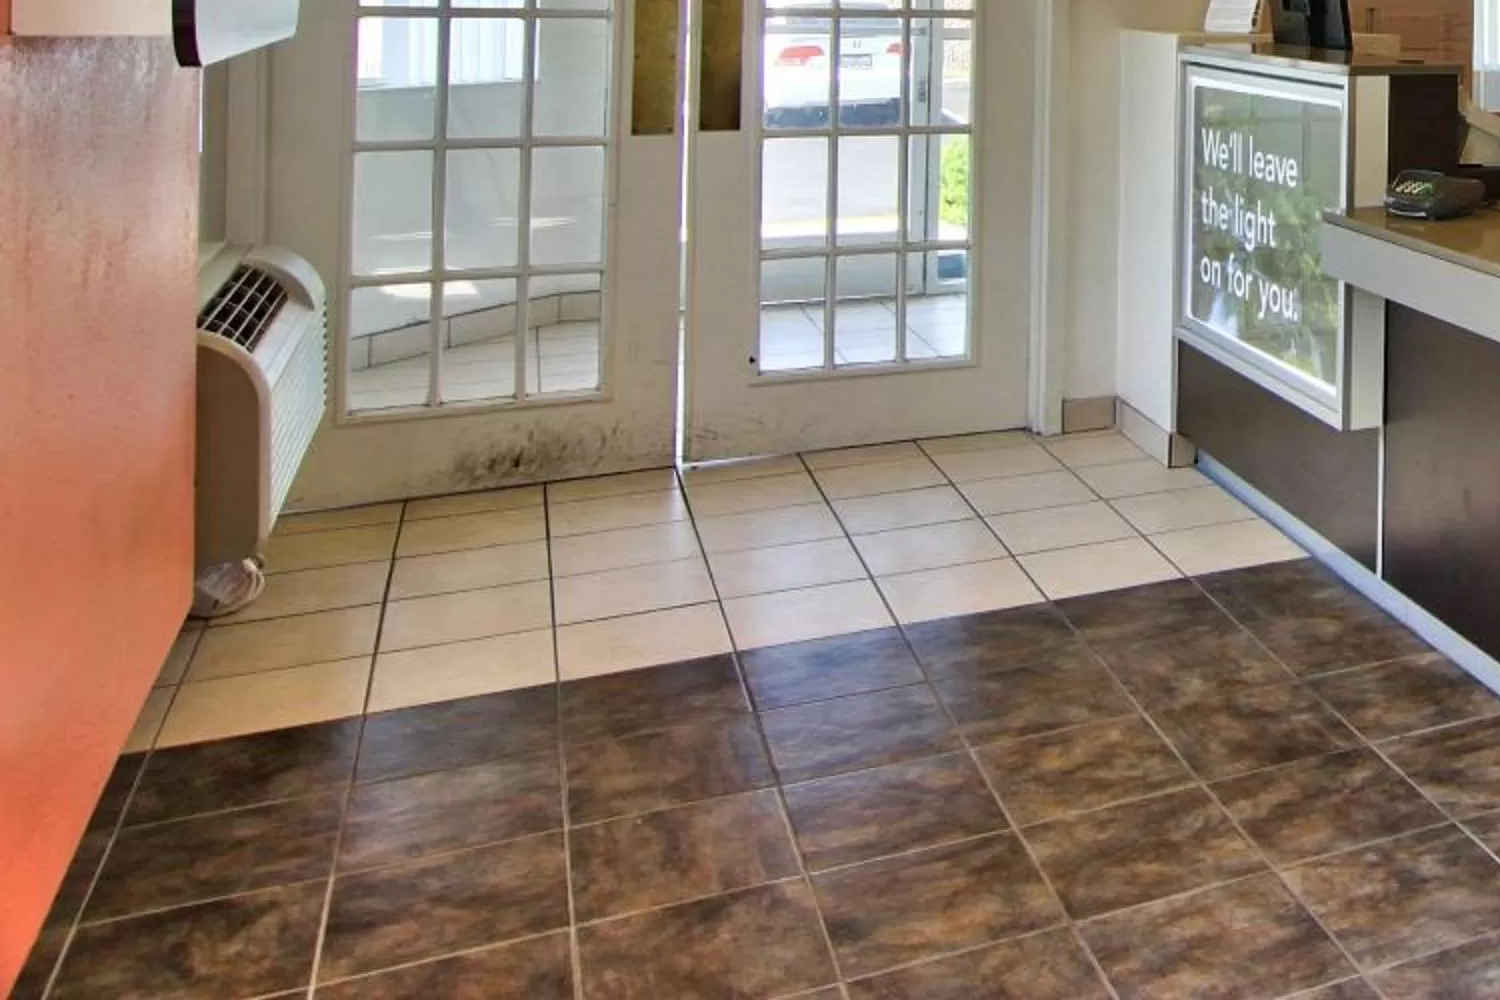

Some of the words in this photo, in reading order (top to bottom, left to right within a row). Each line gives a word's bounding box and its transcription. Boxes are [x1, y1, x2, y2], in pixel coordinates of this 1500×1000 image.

[1201, 126, 1242, 174] We'll
[1248, 135, 1298, 188] leave
[1201, 185, 1229, 230] the
[1234, 192, 1276, 252] light
[1200, 256, 1221, 288] on
[1226, 252, 1253, 301] for
[1257, 279, 1299, 321] you.
